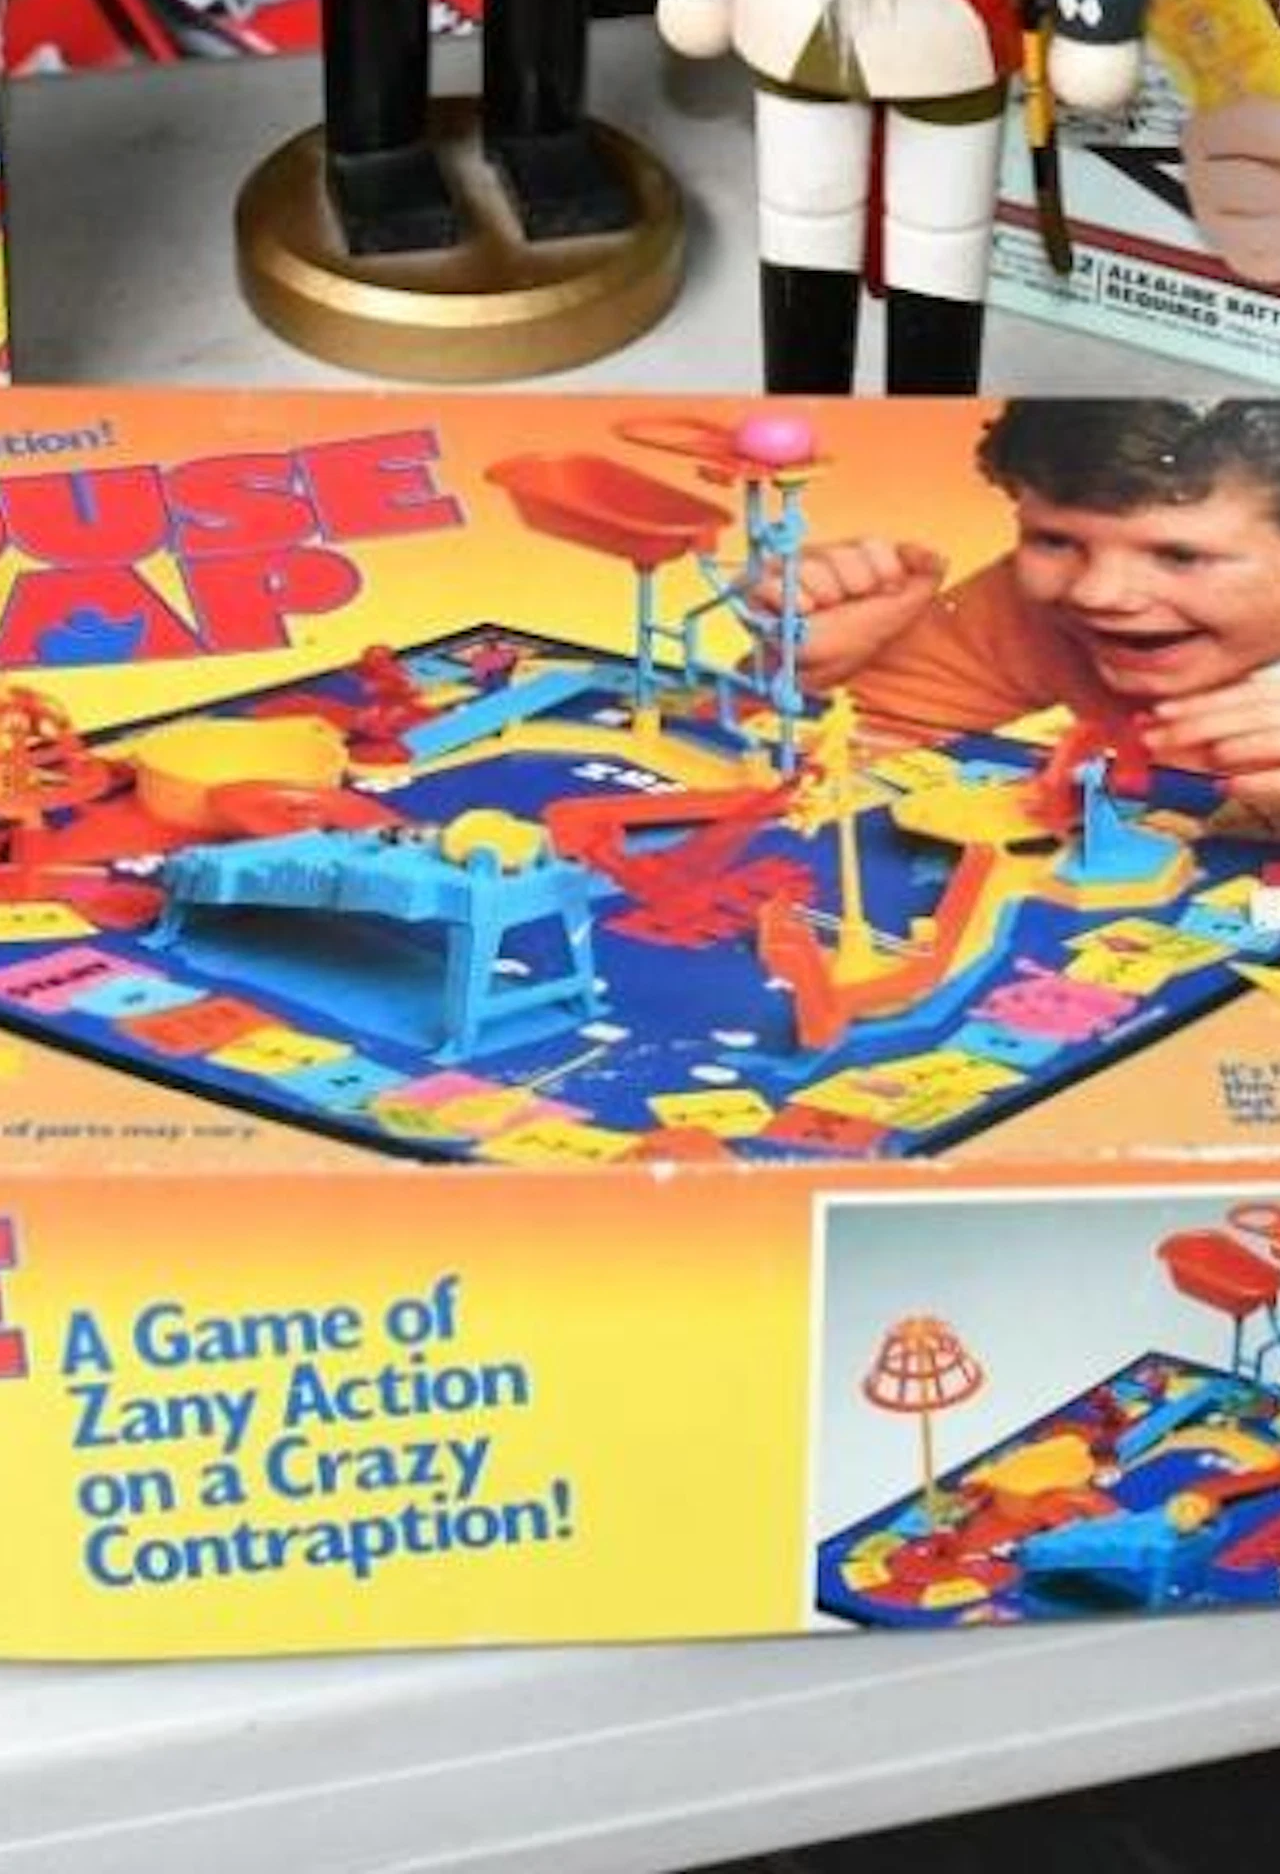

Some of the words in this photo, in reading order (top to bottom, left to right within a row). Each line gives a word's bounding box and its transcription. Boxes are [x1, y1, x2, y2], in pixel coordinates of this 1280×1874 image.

[1106, 282, 1220, 327] REQUIRED
[1107, 264, 1219, 309] ALKALINE
[2, 1118, 32, 1137] of
[34, 1122, 115, 1143] parts
[120, 1124, 182, 1143] may
[60, 1308, 112, 1376] A
[133, 1302, 362, 1368] Game
[384, 1274, 460, 1346] of
[65, 1381, 257, 1456] Zany
[283, 1353, 529, 1429] Action
[77, 1469, 175, 1519] on
[200, 1461, 246, 1508] a
[264, 1435, 491, 1502] Crazy
[84, 1478, 574, 1589] Contraption!
